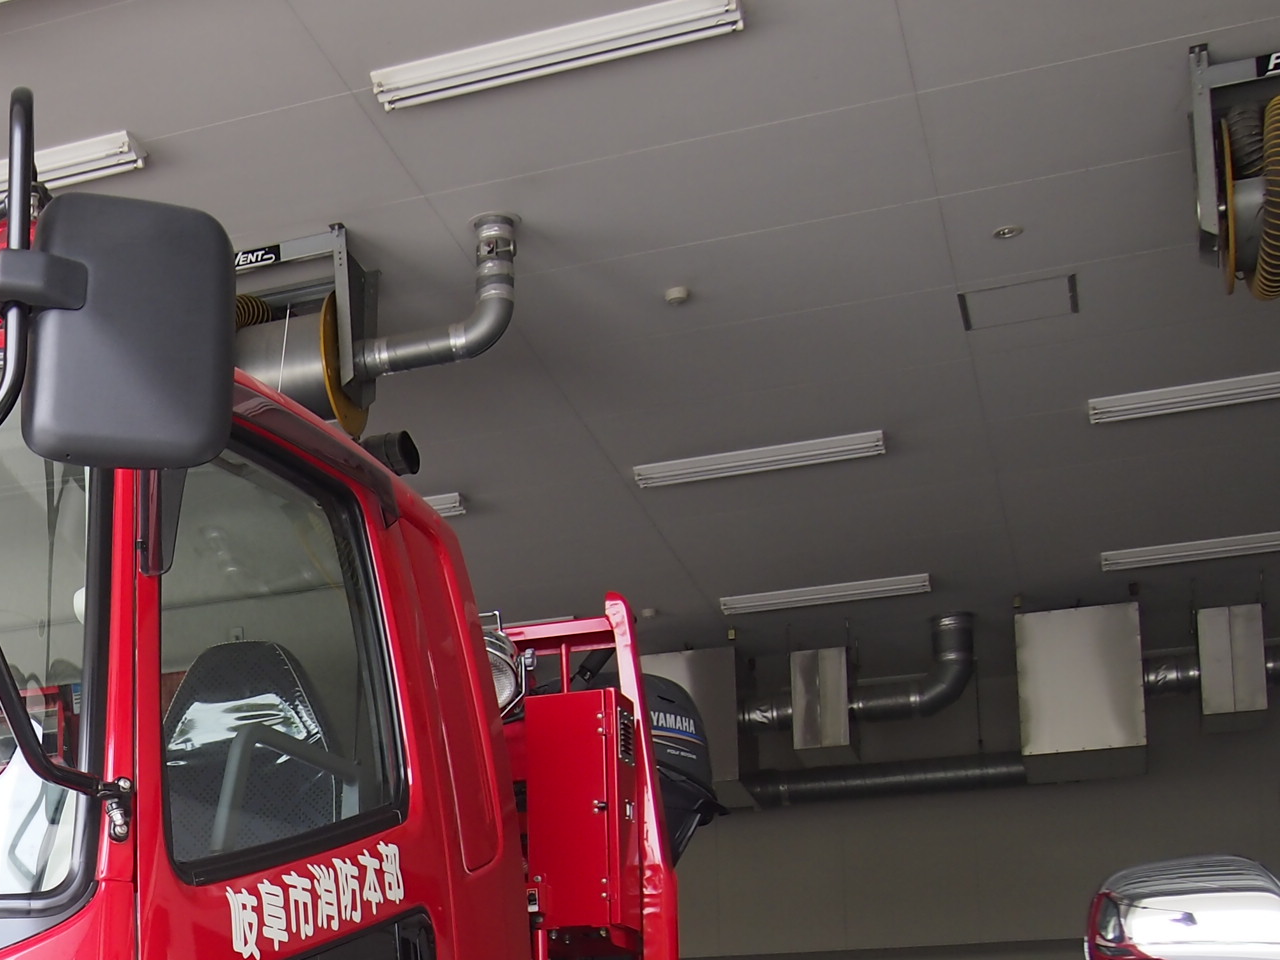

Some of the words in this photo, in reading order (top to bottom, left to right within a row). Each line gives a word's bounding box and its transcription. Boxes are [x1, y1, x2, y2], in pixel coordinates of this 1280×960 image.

[650, 711, 696, 734] YAMAHA
[226, 840, 405, 960] 岐阜市消防本部
